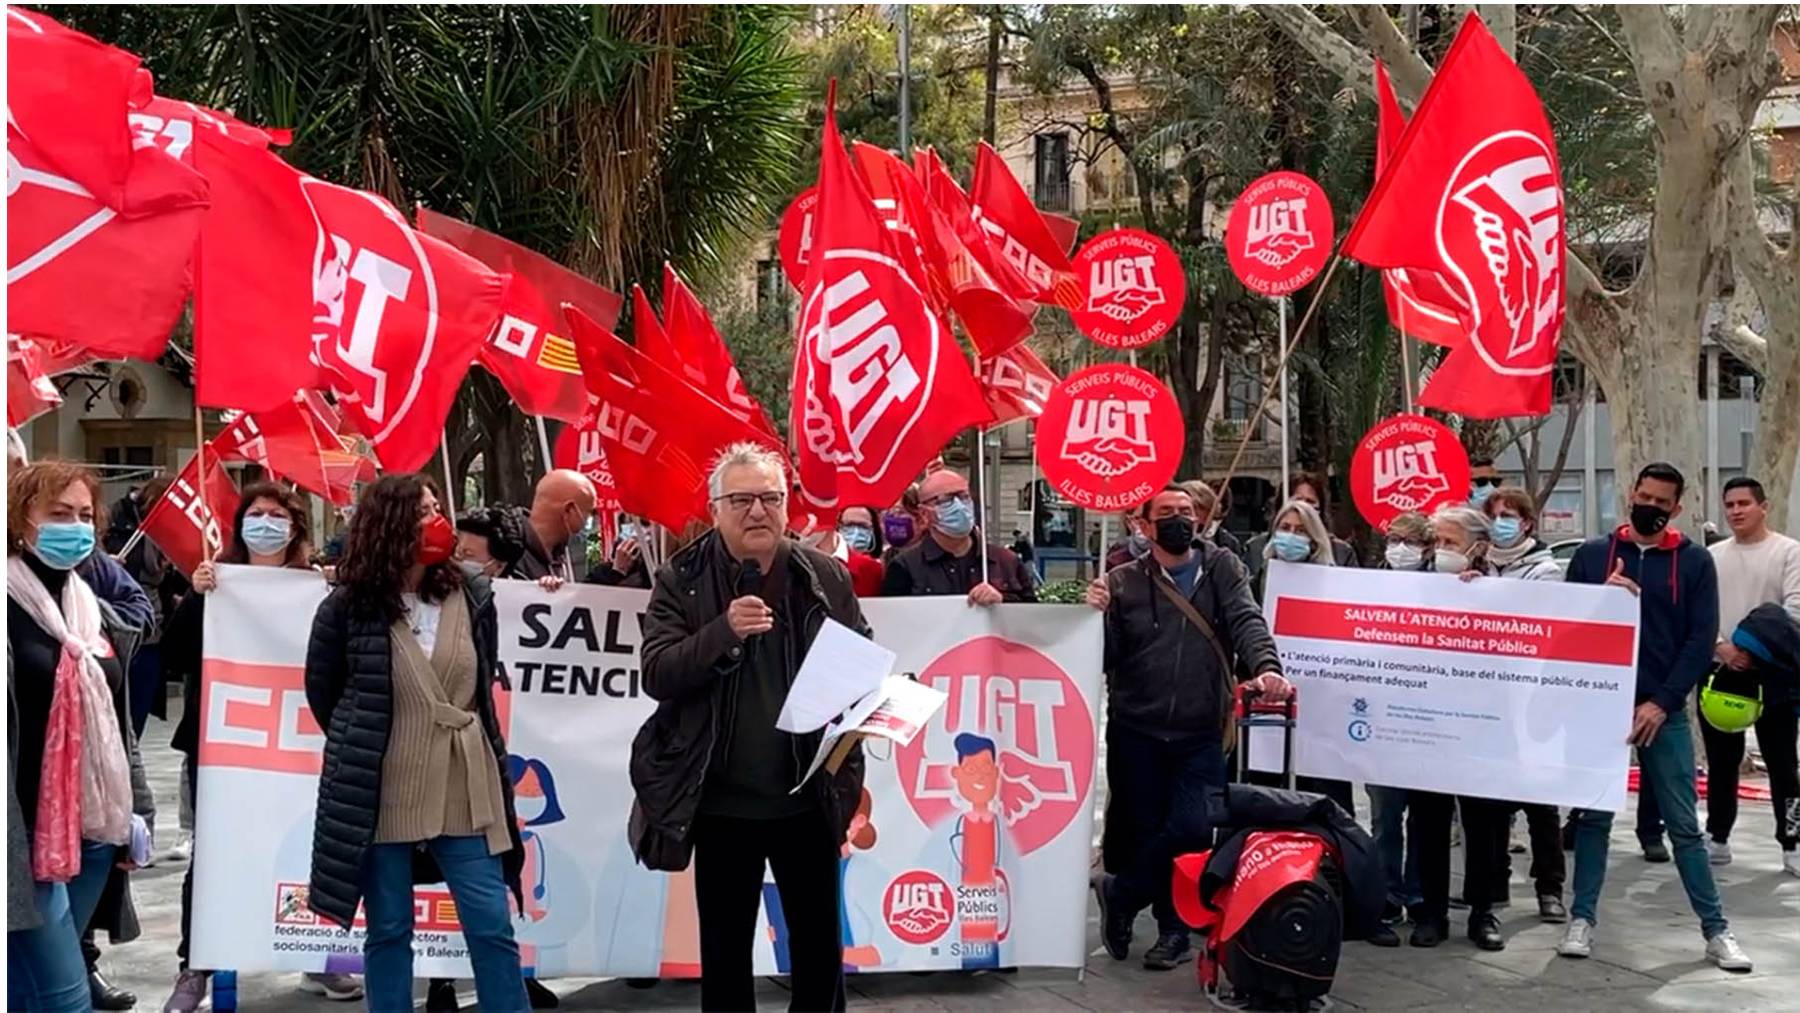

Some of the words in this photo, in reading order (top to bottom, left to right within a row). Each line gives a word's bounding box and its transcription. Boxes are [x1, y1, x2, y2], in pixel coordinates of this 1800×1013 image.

[1247, 198, 1307, 243] UGT
[1090, 255, 1155, 299] UGT
[1091, 327, 1118, 346] ILLES
[1121, 320, 1167, 347] BALEARS
[816, 270, 921, 452] UGT
[1064, 372, 1111, 397] SERVEIS
[1112, 371, 1159, 399] PÚBLICS
[1066, 399, 1151, 445] UGT
[1373, 440, 1437, 488] UGT
[1059, 478, 1092, 504] ILLES
[1095, 481, 1153, 508] BALEARS
[1344, 608, 1397, 624] SALVEM
[1400, 610, 1470, 630] L'ATENCIÓ
[1473, 617, 1544, 637] PRIMÀRIA
[1353, 626, 1419, 645] Defensem
[1421, 632, 1435, 647] la
[1437, 633, 1485, 650] Sanitat
[1487, 637, 1538, 656] Pública
[493, 660, 640, 699] ATENCI
[1285, 665, 1303, 677] Per
[1304, 669, 1318, 679] un
[1318, 667, 1383, 686] finançament
[1384, 676, 1428, 691] adequat
[1332, 654, 1376, 670] primària
[1384, 660, 1450, 678] comunitària,
[1452, 667, 1476, 679] base
[1478, 668, 1496, 681] del
[1497, 671, 1539, 685] sistema
[1540, 674, 1574, 687] públic
[1575, 677, 1590, 689] de
[1592, 679, 1620, 691] salut
[923, 674, 1065, 765] UGT
[891, 883, 944, 913] UGT
[956, 884, 998, 899] Serveis
[957, 899, 999, 914] Públics
[275, 925, 332, 938] federació
[273, 940, 359, 954] sociosanitaris
